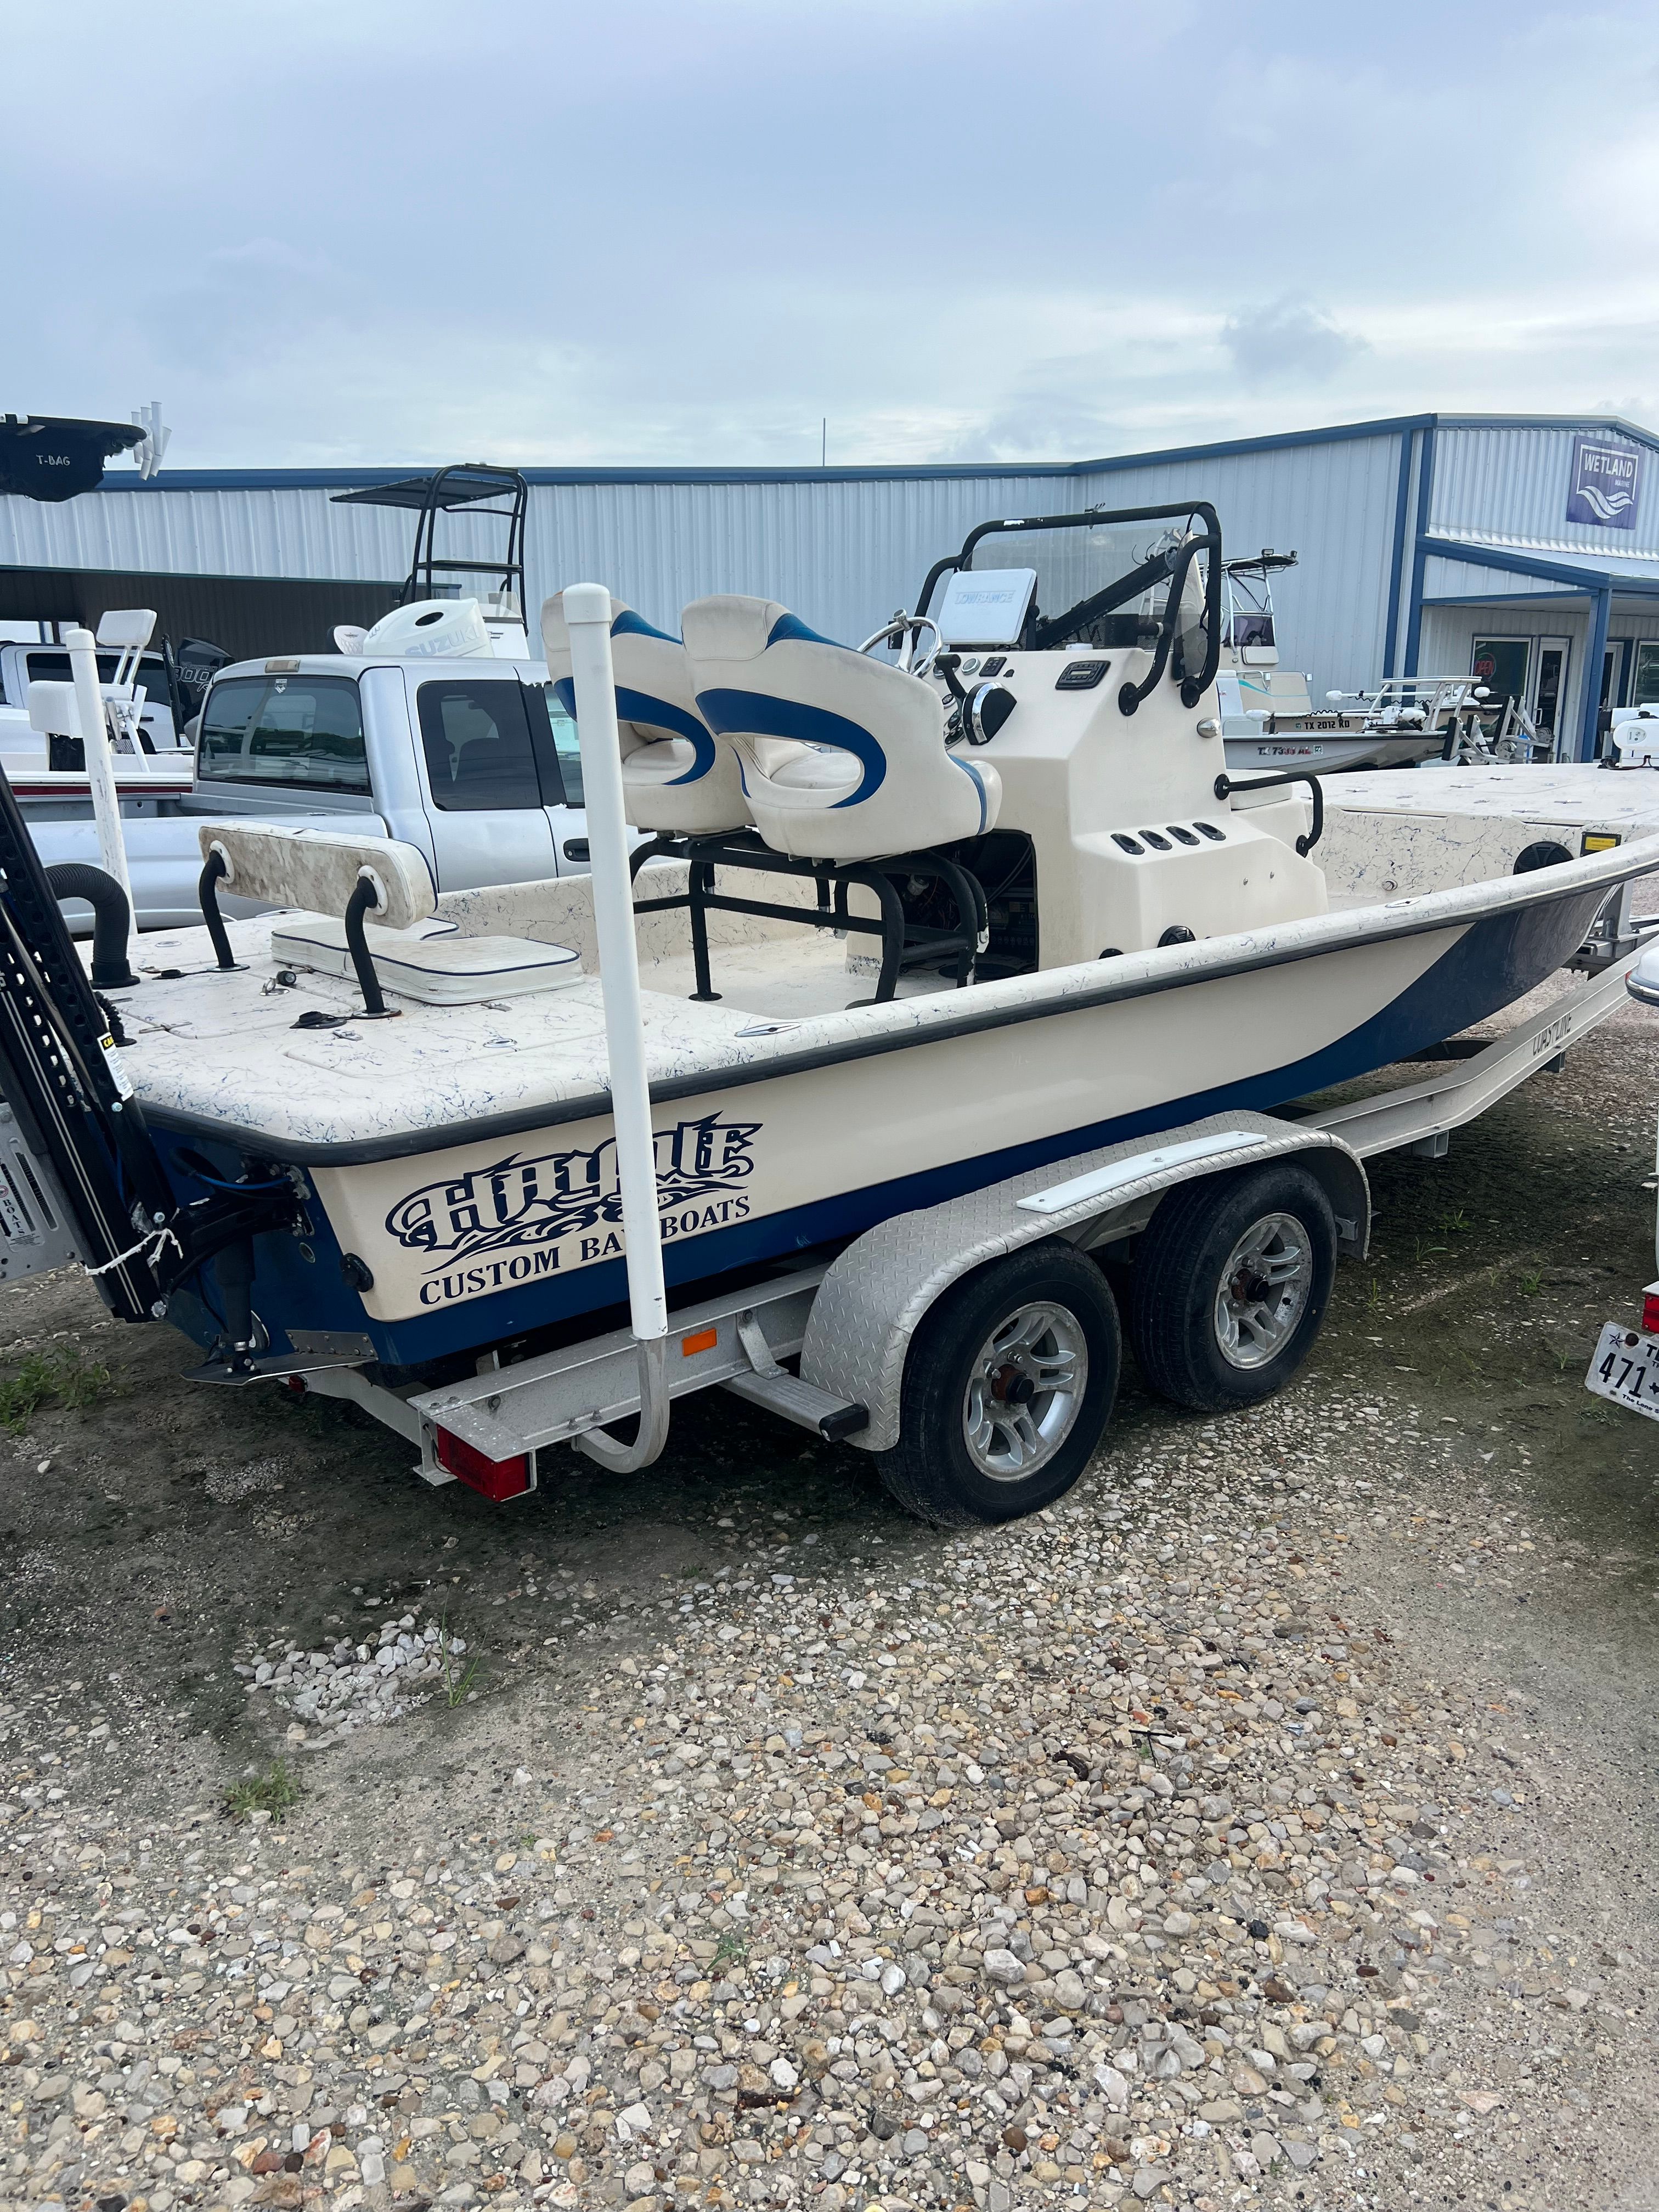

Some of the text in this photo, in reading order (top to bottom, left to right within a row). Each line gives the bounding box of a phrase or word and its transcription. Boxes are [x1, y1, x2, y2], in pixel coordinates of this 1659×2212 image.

[36, 454, 70, 466] T-BAG
[1584, 453, 1633, 478] WETLAND
[1615, 479, 1630, 488] MARINE
[405, 624, 481, 657] SUZUKI
[1304, 721, 1314, 730] TX
[1318, 721, 1335, 729] 2012
[3, 1199, 25, 1235] BOATS
[420, 1195, 750, 1305] CUSTOM BA BOATS
[1599, 1352, 1647, 1398] 471
[1622, 1393, 1635, 1403] The
[1637, 1400, 1653, 1411] Lone
